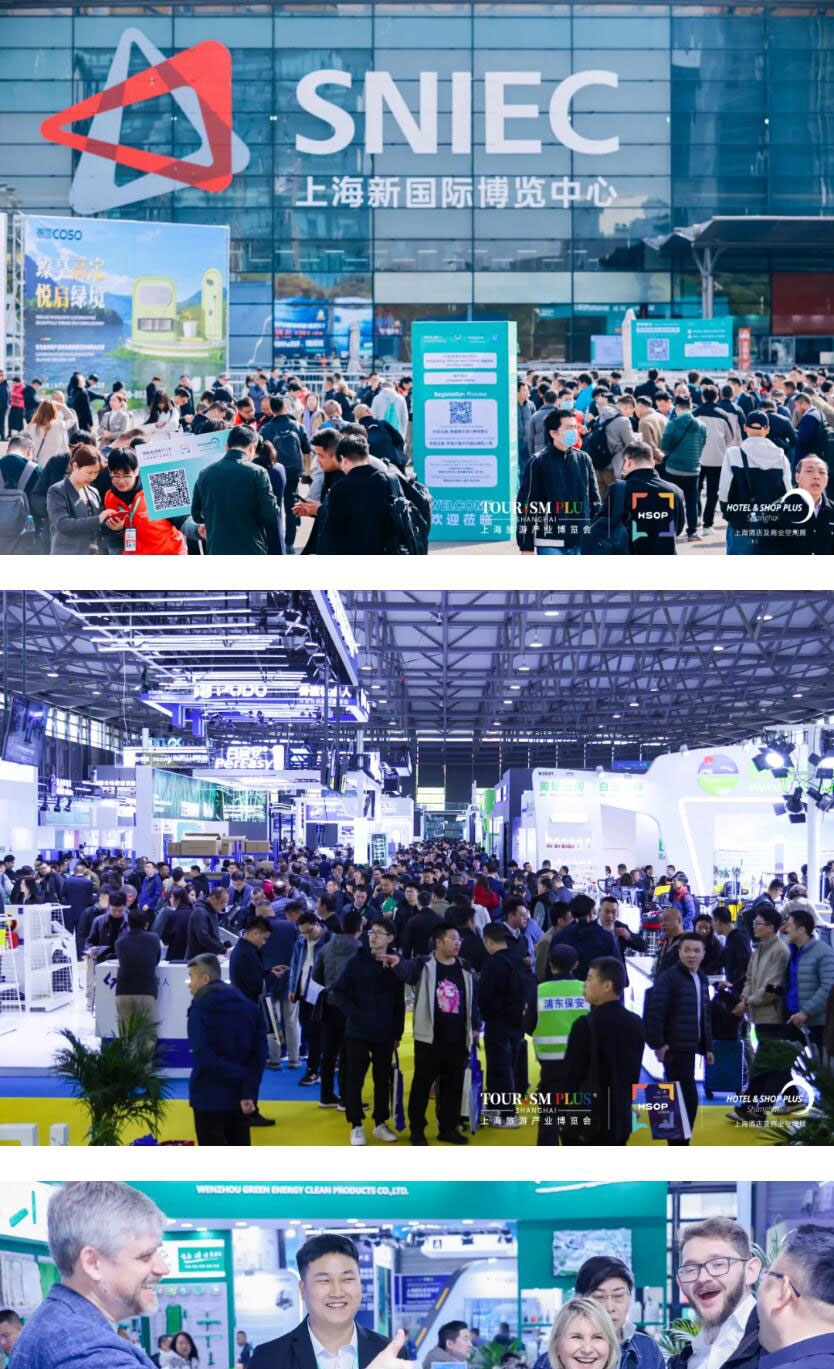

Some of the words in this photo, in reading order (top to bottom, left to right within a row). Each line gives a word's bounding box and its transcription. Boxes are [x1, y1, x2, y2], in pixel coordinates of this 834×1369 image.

[296, 69, 619, 154] SNIEC
[295, 177, 618, 208] 上海新国际博览中心
[53, 229, 83, 241] COSO
[431, 513, 493, 526] 欢迎莅临
[543, 997, 585, 1010] 浦东保安
[196, 1184, 241, 1194] WENZHOU
[242, 1185, 270, 1194] GREEN
[271, 1185, 303, 1195] ENERGY
[304, 1186, 333, 1195] CLEAN
[333, 1187, 376, 1195] PRODUCTS
